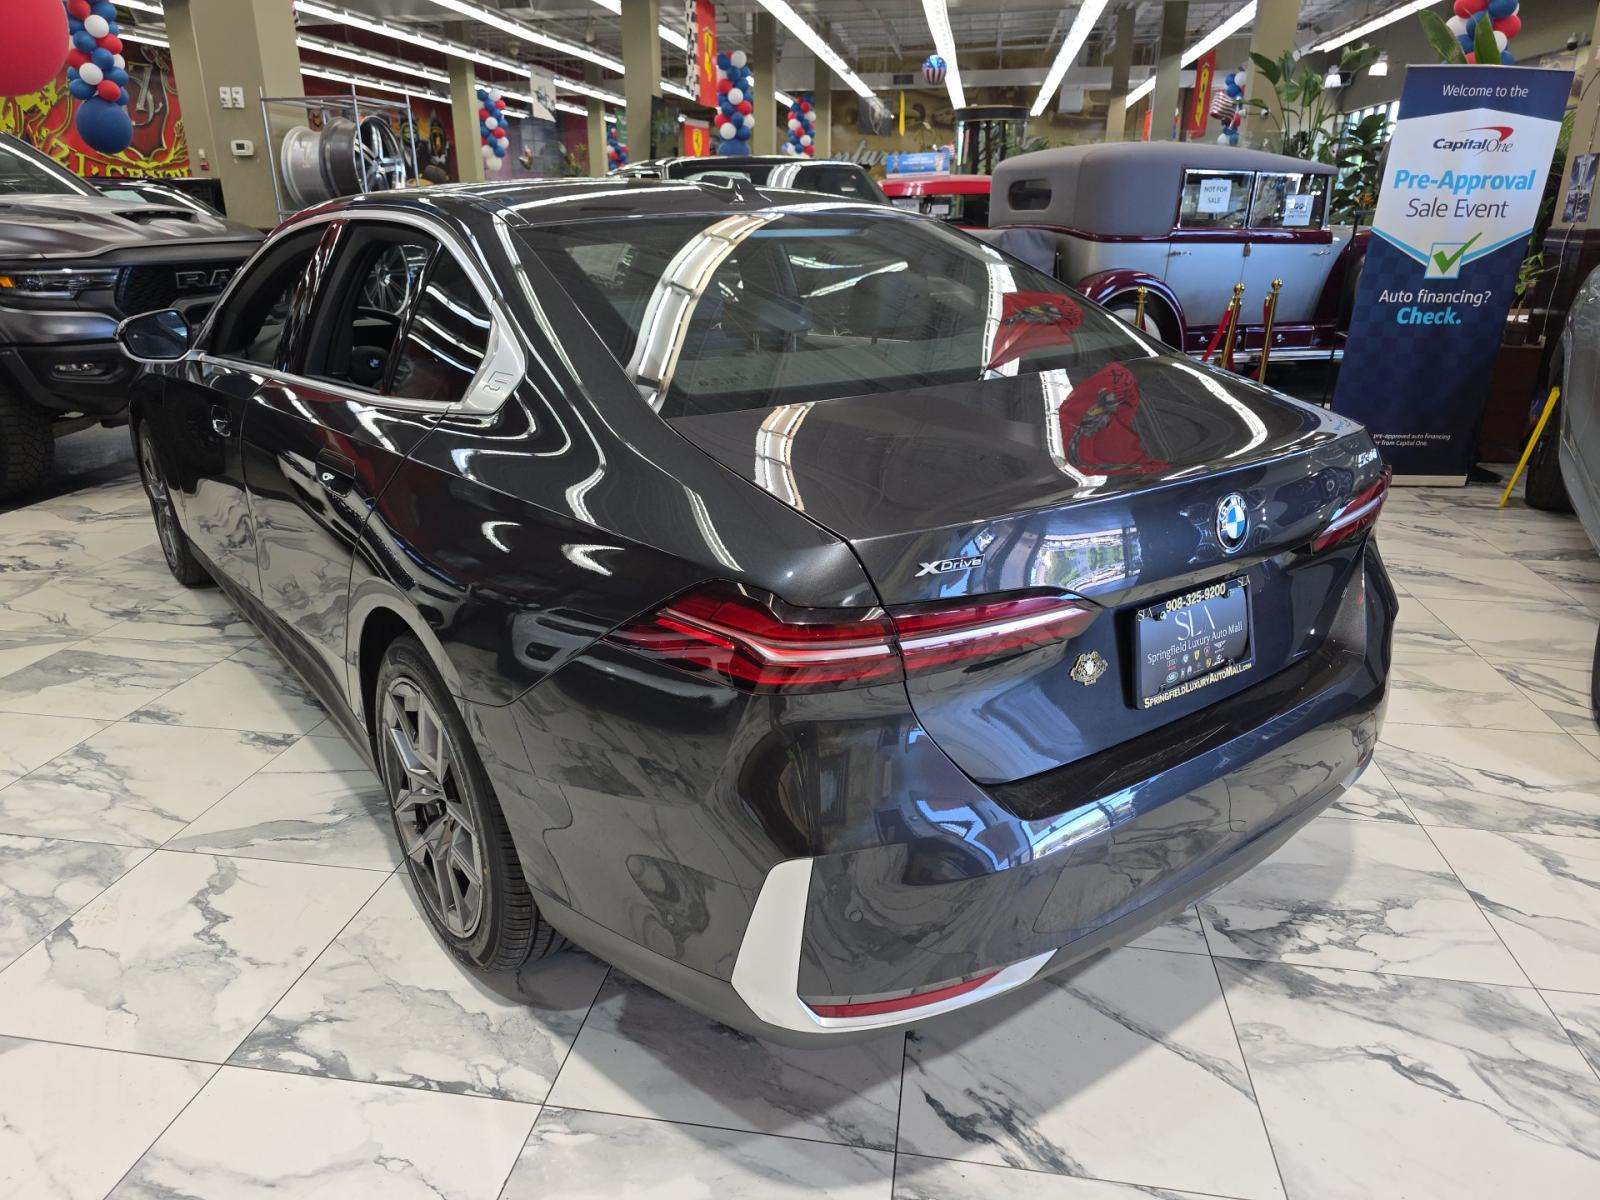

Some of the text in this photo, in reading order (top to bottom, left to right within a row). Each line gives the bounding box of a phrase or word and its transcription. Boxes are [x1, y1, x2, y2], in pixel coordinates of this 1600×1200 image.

[1442, 84, 1529, 98] Welcome to the
[1393, 169, 1537, 195] Pre-Approval
[1405, 197, 1510, 218] Sale Event
[1378, 289, 1492, 307] Auto financing?
[1396, 306, 1462, 325] Check.
[1165, 583, 1226, 613] 908-325-9200
[1147, 620, 1243, 665] Springfield Luxury Auto Mall
